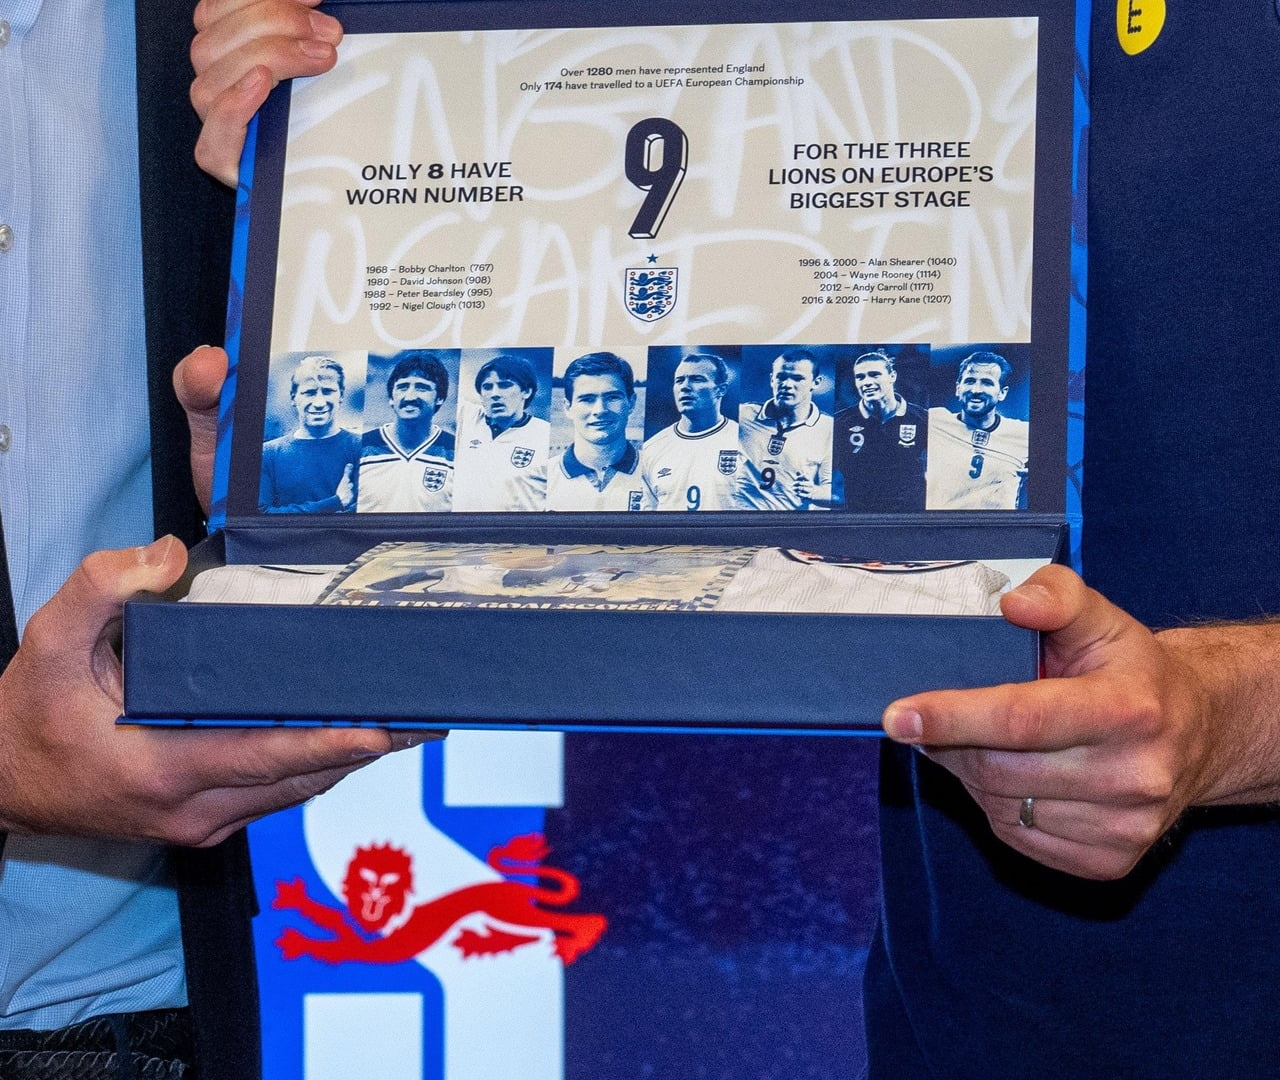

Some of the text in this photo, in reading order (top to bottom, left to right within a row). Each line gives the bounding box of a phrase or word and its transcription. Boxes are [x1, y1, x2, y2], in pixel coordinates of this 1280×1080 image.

[561, 68, 584, 76] Over
[587, 67, 613, 76] 1280
[639, 66, 661, 74] have
[664, 64, 723, 76] represented
[727, 64, 765, 74] England
[520, 82, 541, 92] Only
[544, 82, 562, 90] 174
[565, 81, 587, 90] have
[590, 80, 632, 89] travelled
[656, 79, 683, 88] UEFA
[686, 79, 732, 88] European
[735, 76, 804, 87] Championship
[794, 141, 971, 160] FOR THE THREE
[361, 162, 512, 181] ONLY 8 HAVE
[624, 118, 689, 239] 9
[769, 168, 835, 184] LIONS
[842, 167, 875, 183] ON
[345, 186, 524, 205] WORN NUMBER
[790, 190, 971, 209] BIGGEST STAGE
[399, 265, 426, 274] Bobby
[470, 264, 493, 272] (767)
[927, 258, 956, 266] (1040)
[400, 277, 424, 285] David
[466, 276, 490, 285] (908)
[814, 271, 837, 279] 2004
[850, 271, 879, 280] Wayne
[882, 271, 913, 280] Rooney
[916, 270, 941, 279] (1114)
[423, 289, 464, 298] Beardsley
[468, 288, 492, 297] (995)
[853, 284, 875, 293] Andy
[878, 283, 907, 291] Carroll
[910, 283, 933, 292] (1171)
[402, 302, 424, 311] Nigel
[427, 302, 456, 310] Clough
[459, 301, 485, 309] (1013)
[826, 296, 833, 304] &
[836, 296, 859, 304] 2020
[871, 296, 896, 305] Harry
[923, 295, 951, 304] (1207)
[849, 432, 865, 454] 9
[968, 453, 985, 479] 9
[759, 467, 776, 490] 9
[686, 485, 701, 511] 9
